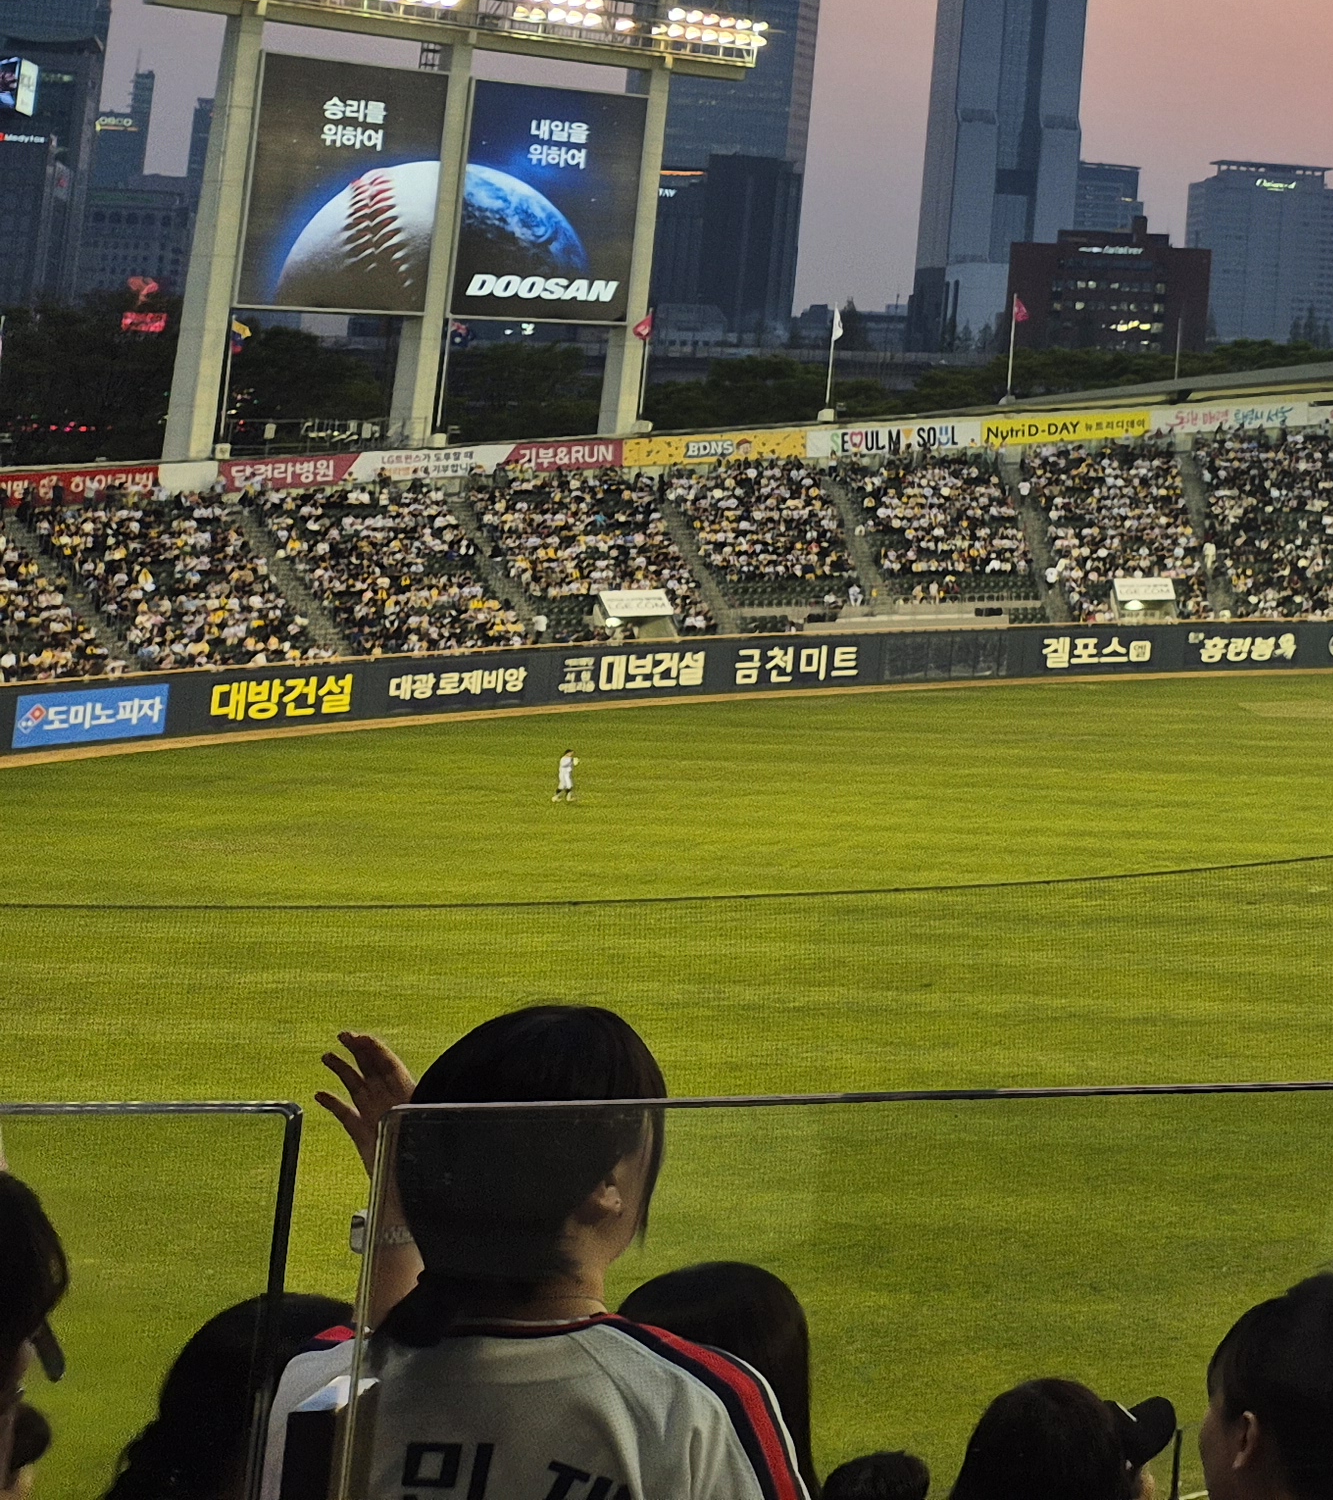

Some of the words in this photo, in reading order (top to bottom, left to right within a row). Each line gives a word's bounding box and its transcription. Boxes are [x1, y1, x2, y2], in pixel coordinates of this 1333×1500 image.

[322, 95, 388, 125] 승리를
[320, 123, 385, 151] 위하여
[530, 118, 591, 145] 내일을
[526, 143, 588, 170] 위하여
[465, 272, 621, 303] DOOSAN
[518, 445, 614, 470] 기부&RUN
[687, 439, 735, 457] BDNS
[598, 650, 707, 691] 대보건설
[733, 644, 860, 686] 금천미트
[209, 672, 355, 722] 대방건설
[42, 695, 164, 731] 도미노피자
